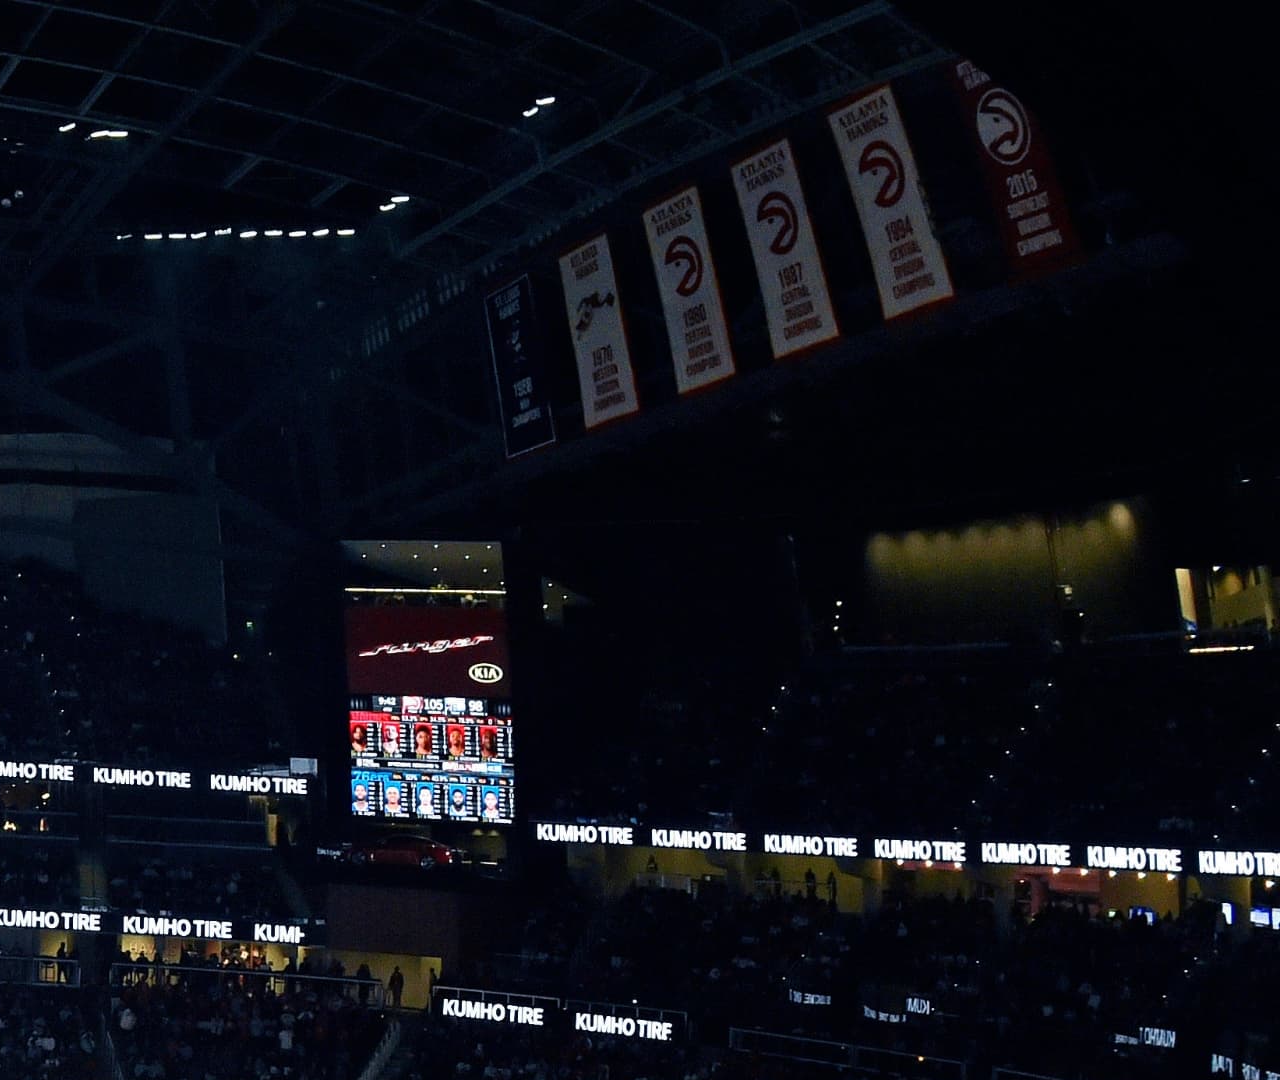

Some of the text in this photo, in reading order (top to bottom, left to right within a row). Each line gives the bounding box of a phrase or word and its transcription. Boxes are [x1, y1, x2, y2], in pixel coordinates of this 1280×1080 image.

[839, 95, 888, 129] ATLANTA
[846, 113, 889, 142] HAWKS
[740, 149, 785, 179] ATLANTA
[746, 165, 785, 192] HAWKS
[650, 195, 694, 224] ATLANTA
[656, 210, 692, 237] HAWKS
[885, 215, 913, 243] 1994
[778, 262, 802, 289] 1987
[473, 666, 497, 680] KIA
[423, 698, 444, 711] 105
[468, 700, 483, 712] 98
[38, 763, 75, 782] TIRE
[93, 767, 192, 789] KUMHO TIRE
[210, 774, 308, 795] KUMHO TIRE
[536, 823, 634, 845] KUMHO TIRE
[651, 828, 747, 851] KUMHO TIRE
[764, 834, 859, 857] KUMHO TIRE
[874, 838, 967, 862] KUMHO TIRE
[981, 842, 1072, 866] KUMHO TIRE
[1087, 845, 1183, 872] KUMHO TIRE
[1198, 850, 1254, 876] KUMHO
[61, 912, 101, 932] TIRE
[123, 915, 233, 939] KUMHO TIRE
[442, 998, 544, 1026] KUMHO TIRE
[575, 1012, 673, 1041] KUMHO TIRE
